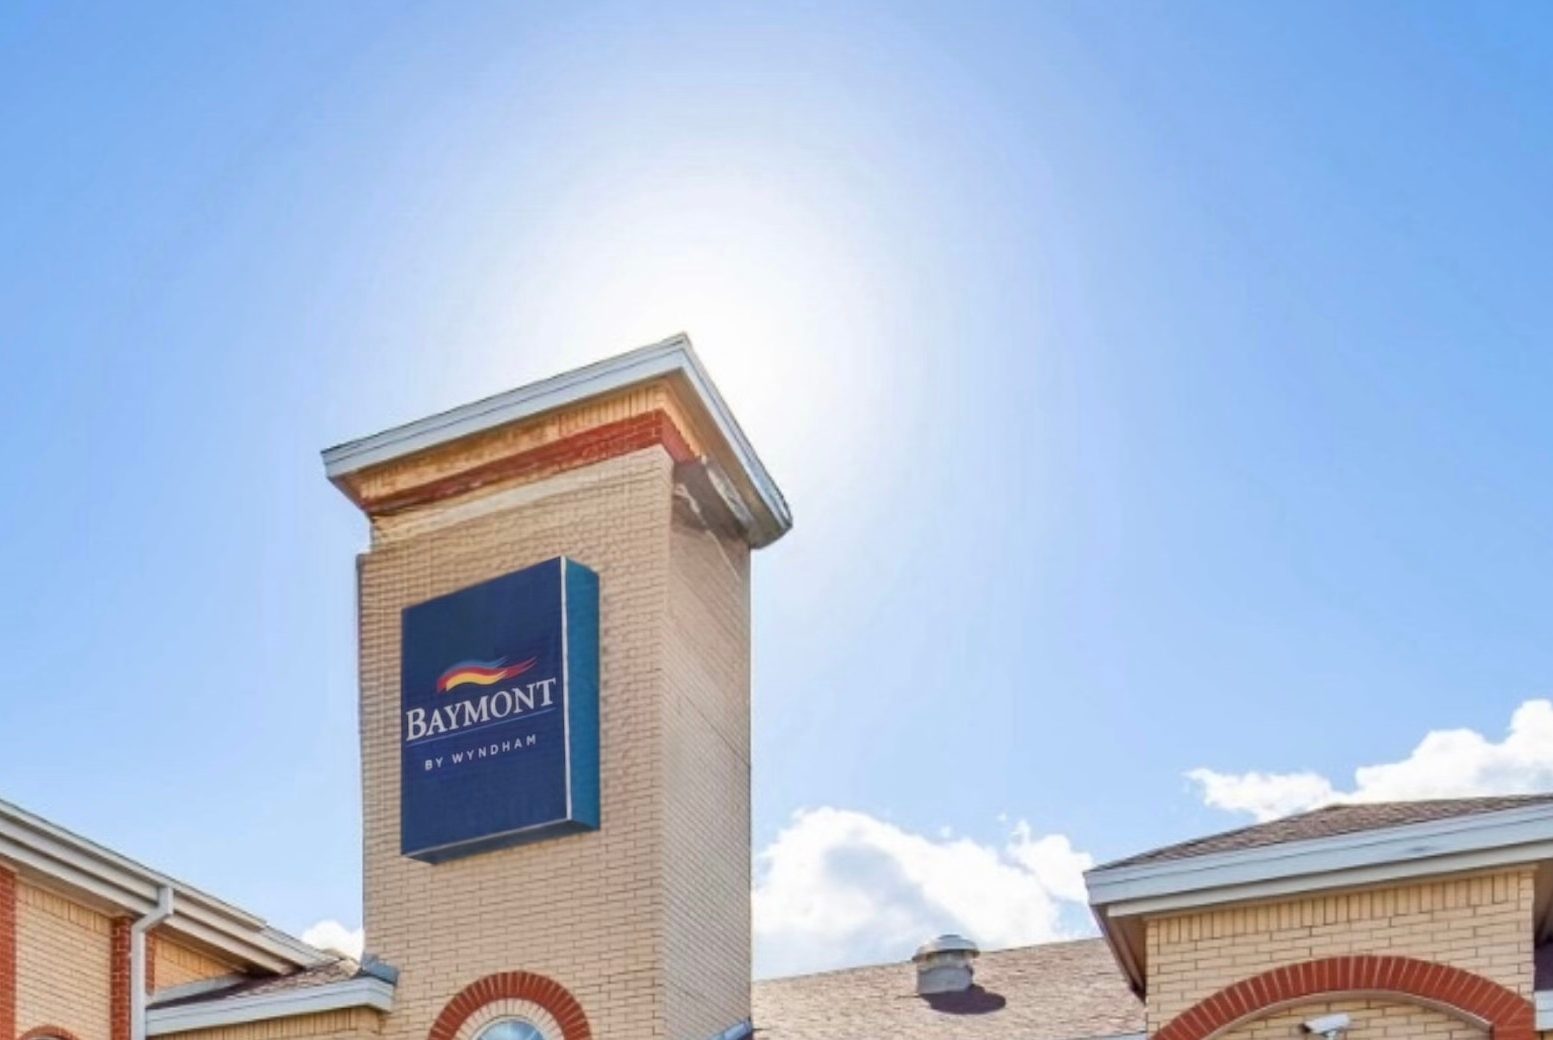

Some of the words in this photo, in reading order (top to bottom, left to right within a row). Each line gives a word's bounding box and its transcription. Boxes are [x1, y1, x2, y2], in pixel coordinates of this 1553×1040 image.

[405, 678, 556, 742] BAYMONT
[424, 757, 444, 771] BY
[452, 734, 537, 764] WYNDHAM
